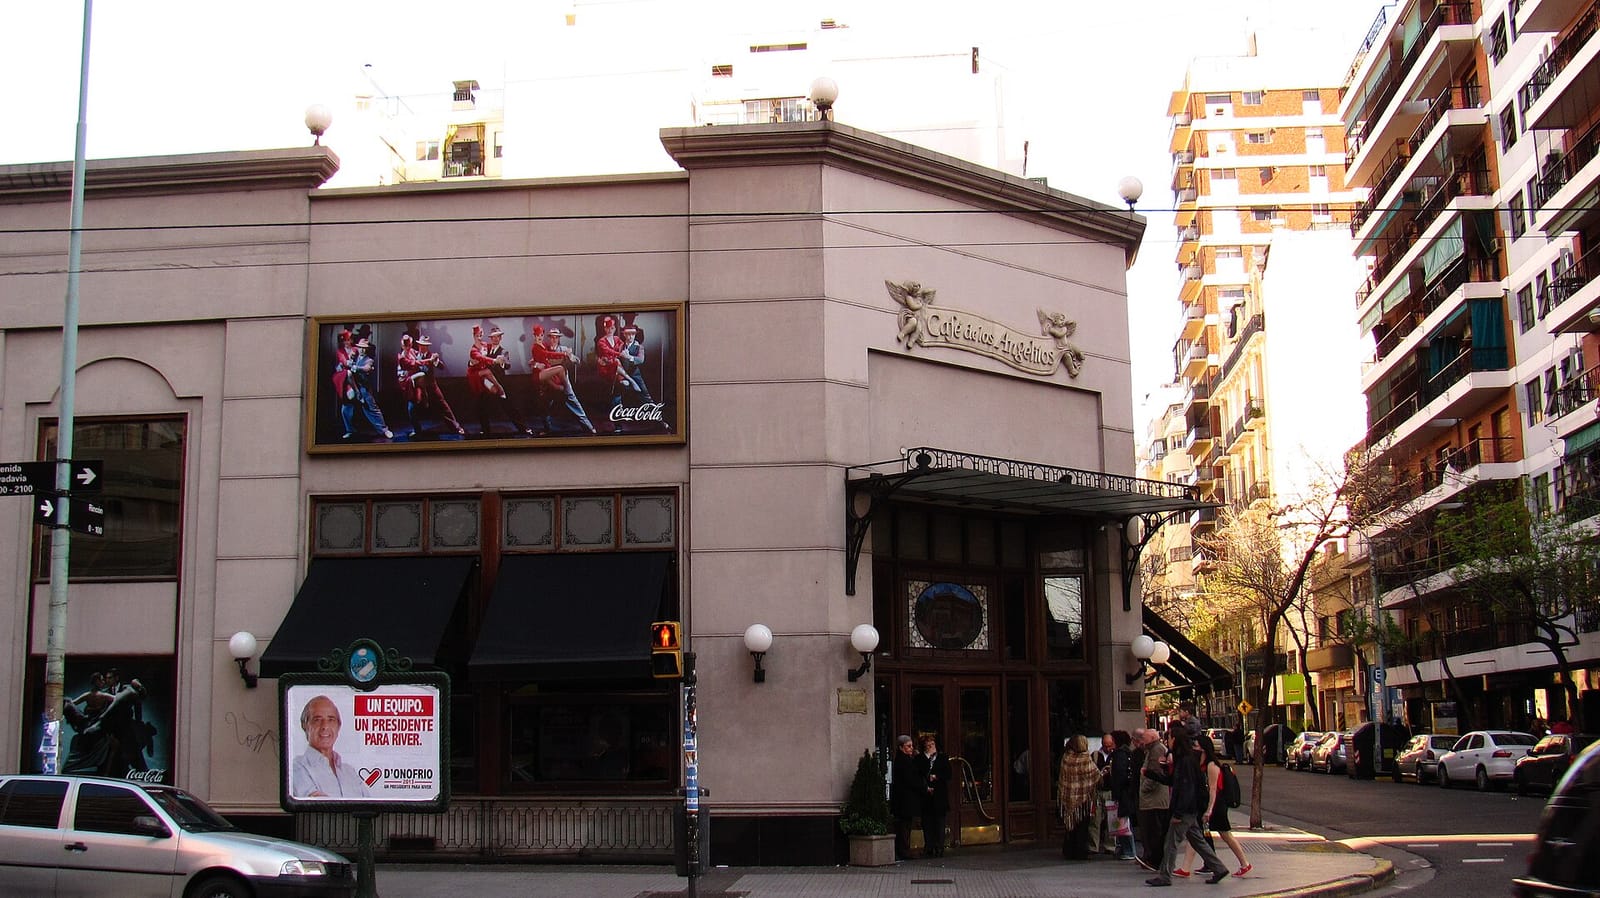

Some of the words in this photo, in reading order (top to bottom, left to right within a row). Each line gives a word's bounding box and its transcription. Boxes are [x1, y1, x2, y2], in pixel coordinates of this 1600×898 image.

[927, 314, 961, 342] Café
[14, 484, 34, 494] 2100
[367, 698, 382, 713] UN
[384, 698, 424, 715] EQUIPO.
[354, 718, 369, 732] UN
[372, 718, 433, 732] PRESIDENTE
[364, 732, 390, 746] PARA
[391, 732, 422, 746] RIVER.
[383, 769, 433, 779] D'ONOFRIO
